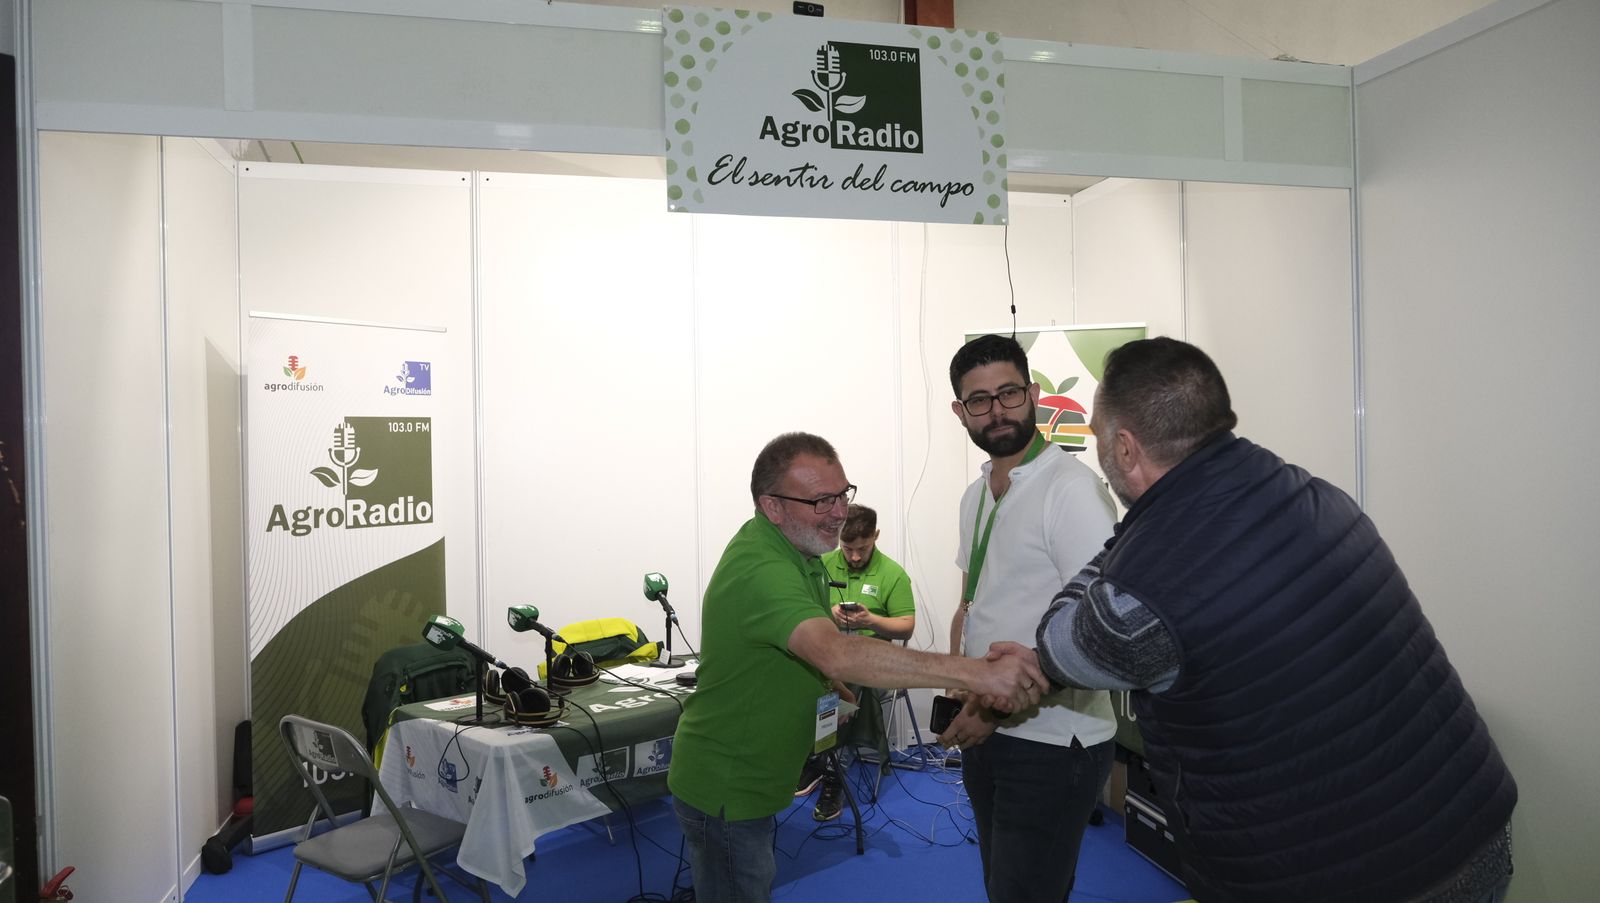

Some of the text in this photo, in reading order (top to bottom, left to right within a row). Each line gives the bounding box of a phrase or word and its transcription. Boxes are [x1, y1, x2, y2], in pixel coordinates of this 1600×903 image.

[869, 49, 917, 63] 103.0 FM
[759, 115, 920, 149] AgroRadio
[707, 154, 975, 208] El sentir del campo
[419, 363, 430, 371] TV
[264, 382, 324, 392] agrodifusión
[388, 422, 430, 433] 103.0 FM
[266, 496, 432, 537] AgroRadio
